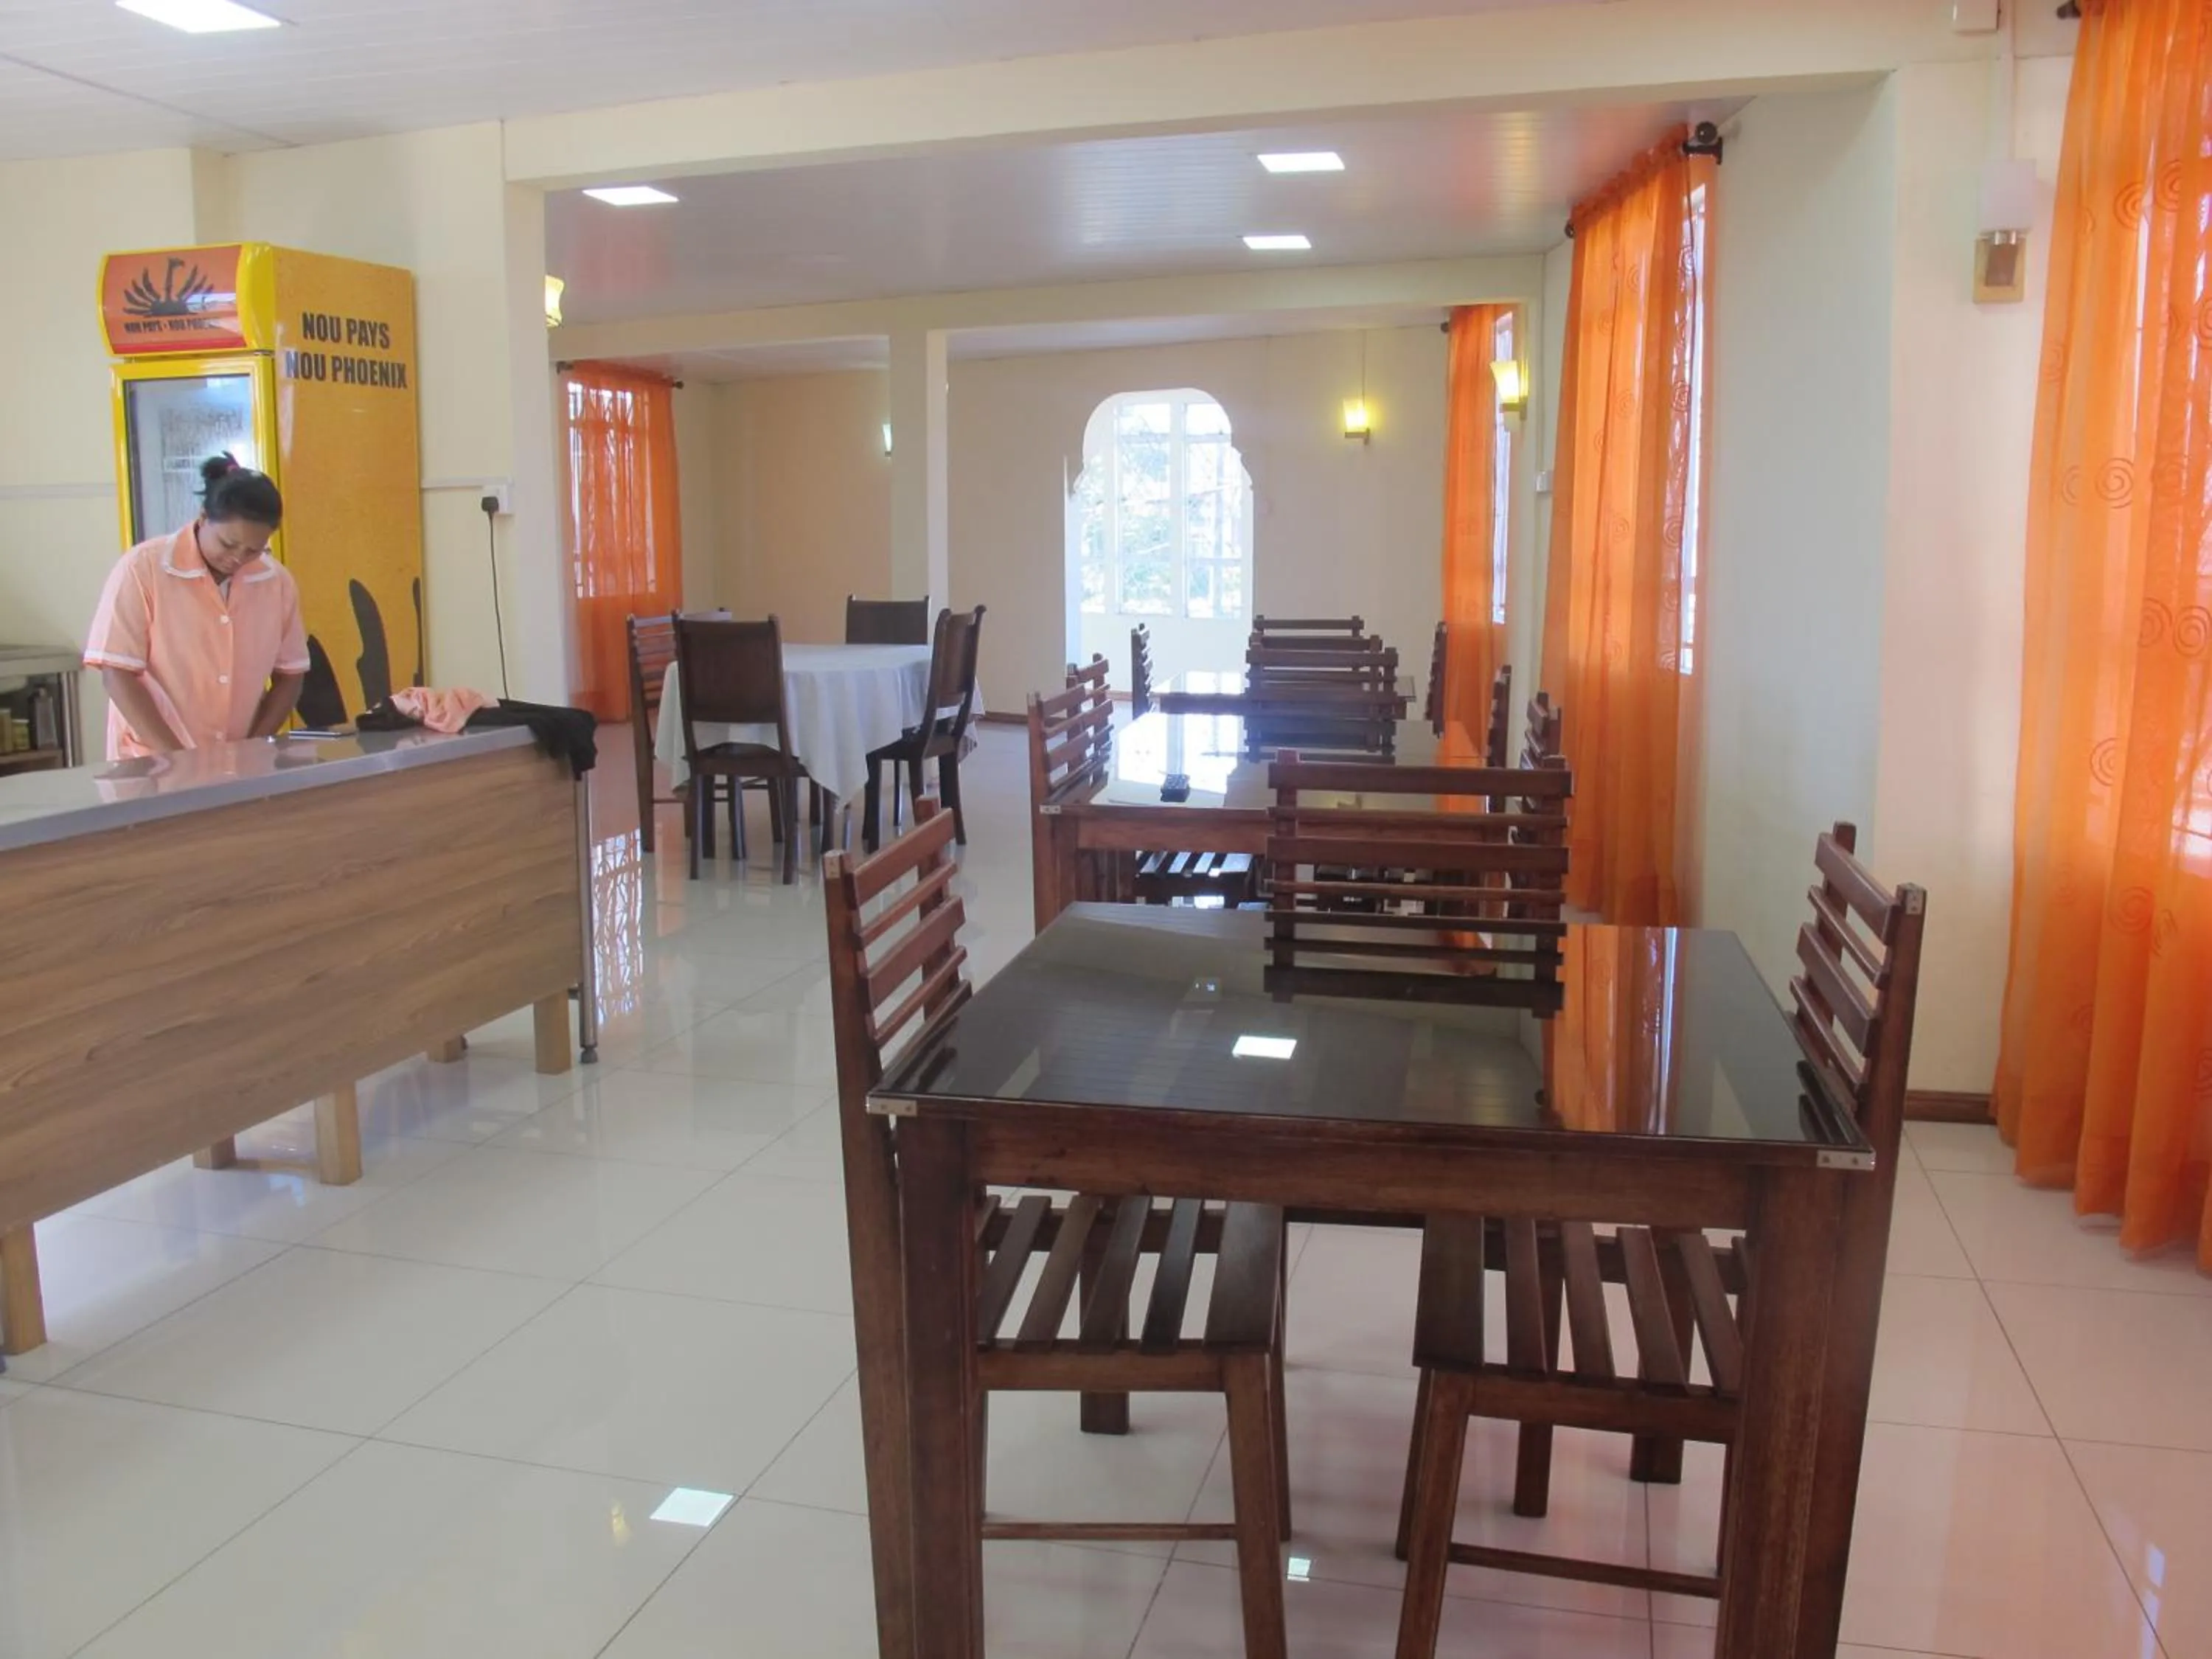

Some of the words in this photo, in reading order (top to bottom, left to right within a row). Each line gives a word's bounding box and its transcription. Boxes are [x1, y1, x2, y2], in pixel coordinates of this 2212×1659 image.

[302, 312, 341, 343] NOU
[347, 318, 389, 349] PAYS
[285, 350, 327, 382] NOU
[330, 355, 407, 389] PHOENIX
